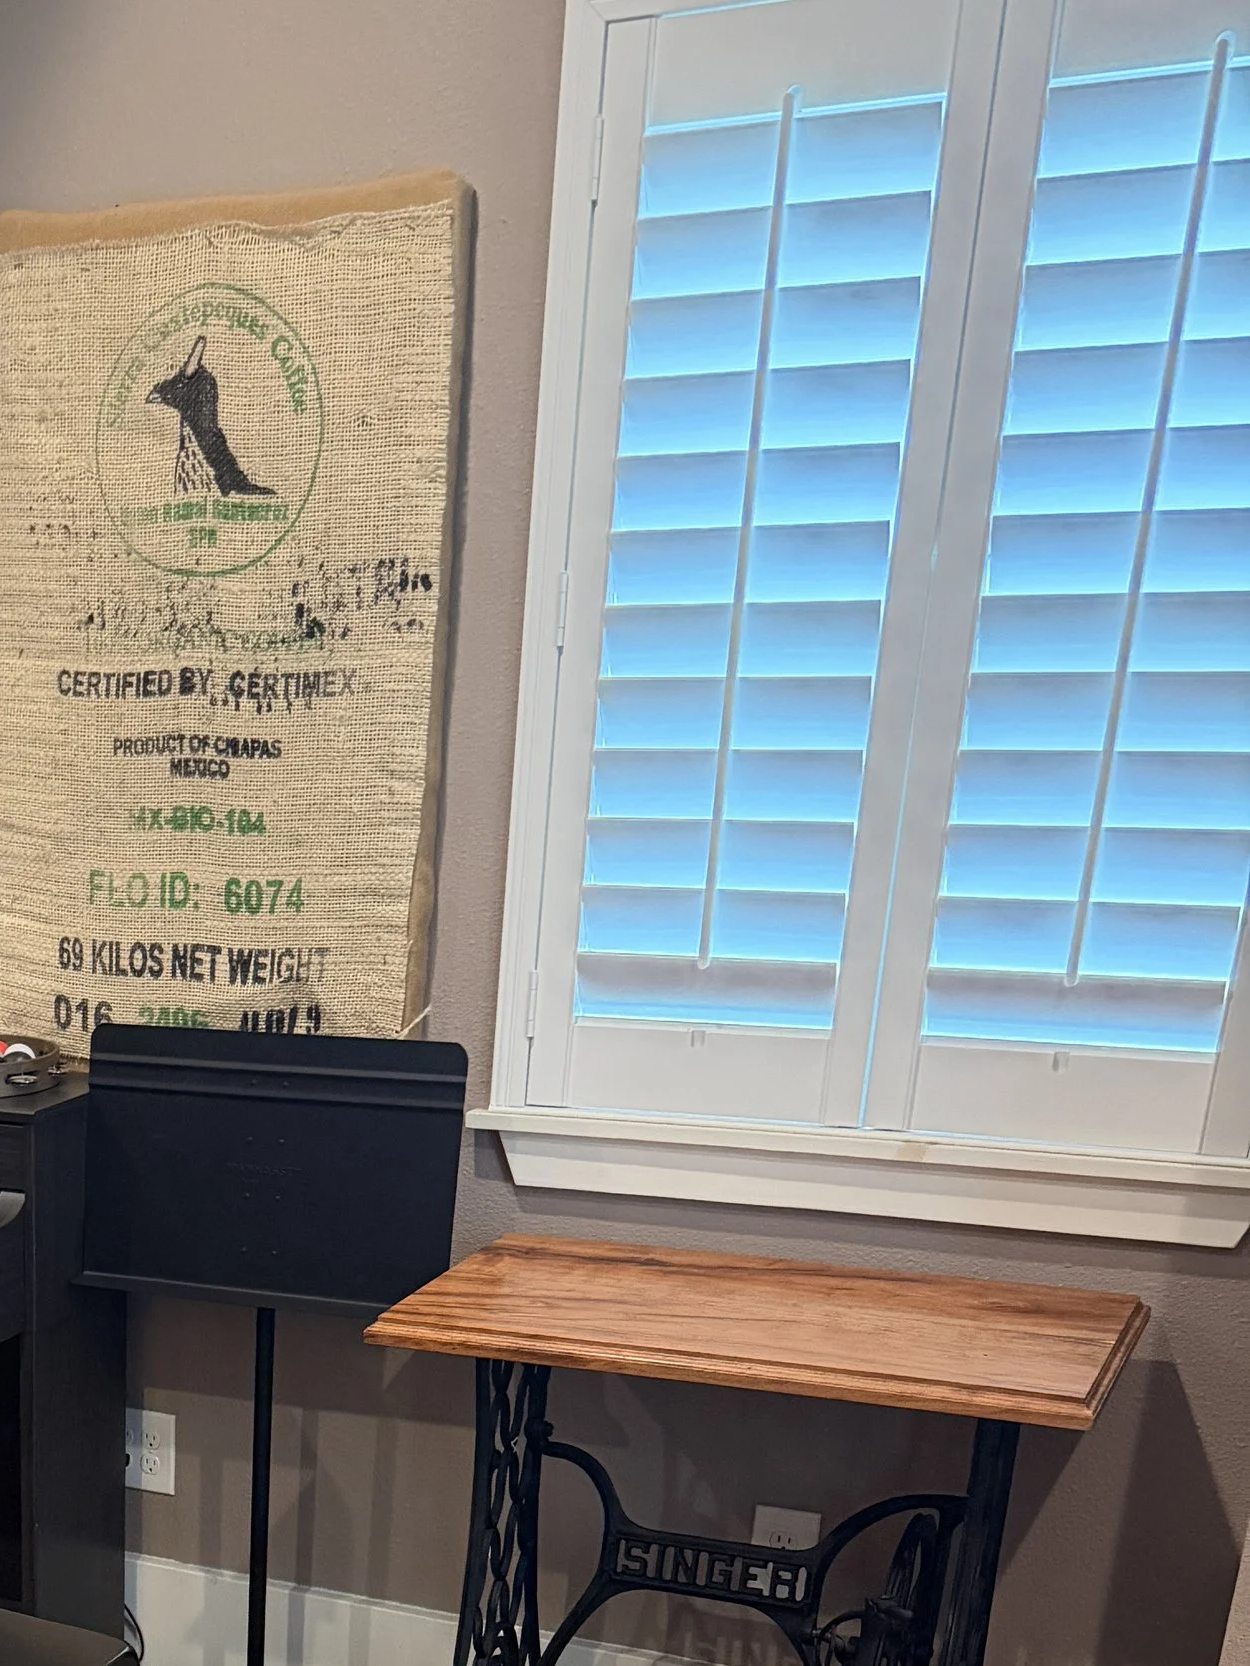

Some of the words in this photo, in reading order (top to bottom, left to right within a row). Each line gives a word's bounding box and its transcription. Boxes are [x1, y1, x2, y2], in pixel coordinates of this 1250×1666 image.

[58, 668, 172, 698] CERTIFIED
[179, 667, 212, 696] BY
[113, 733, 186, 757] PRODUCT
[189, 734, 210, 755] OF
[170, 758, 230, 779] MEXICO
[89, 869, 149, 908] FLO
[224, 876, 305, 916] 6074
[58, 936, 84, 971] 69
[92, 938, 165, 979] KILOS
[171, 943, 222, 985] NET
[227, 946, 330, 986] WEIGHT
[622, 1540, 803, 1604] SINGER
